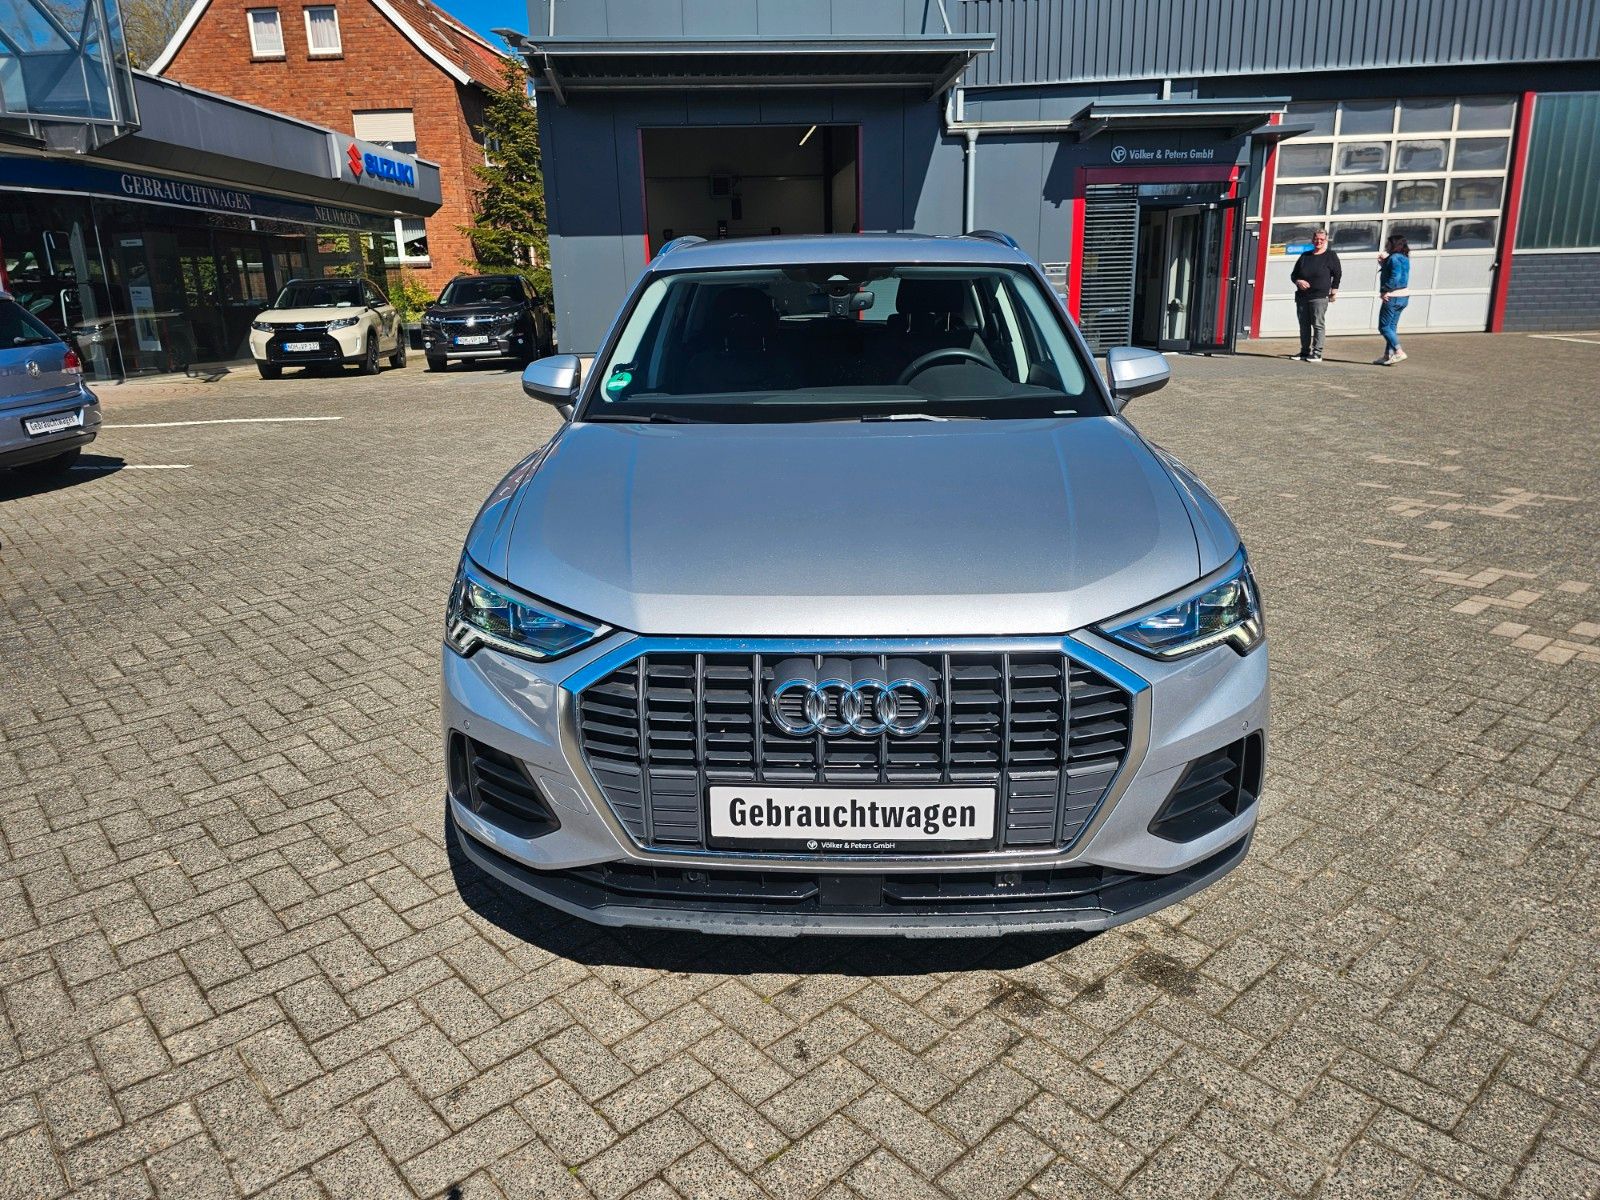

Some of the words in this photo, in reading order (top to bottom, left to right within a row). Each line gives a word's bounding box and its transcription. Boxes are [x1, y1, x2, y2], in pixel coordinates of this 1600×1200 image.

[1129, 149, 1154, 159] Völker
[1156, 149, 1162, 159] &
[1165, 149, 1187, 159] Peters
[1190, 148, 1214, 159] GmbH
[364, 152, 414, 188] SUZUKI
[121, 174, 252, 210] GEBRAUCHTWAGEN
[314, 206, 361, 226] NEUWAGEN
[30, 416, 76, 431] Gebrauchtwagen
[729, 797, 976, 834] Gebrauchtwagen
